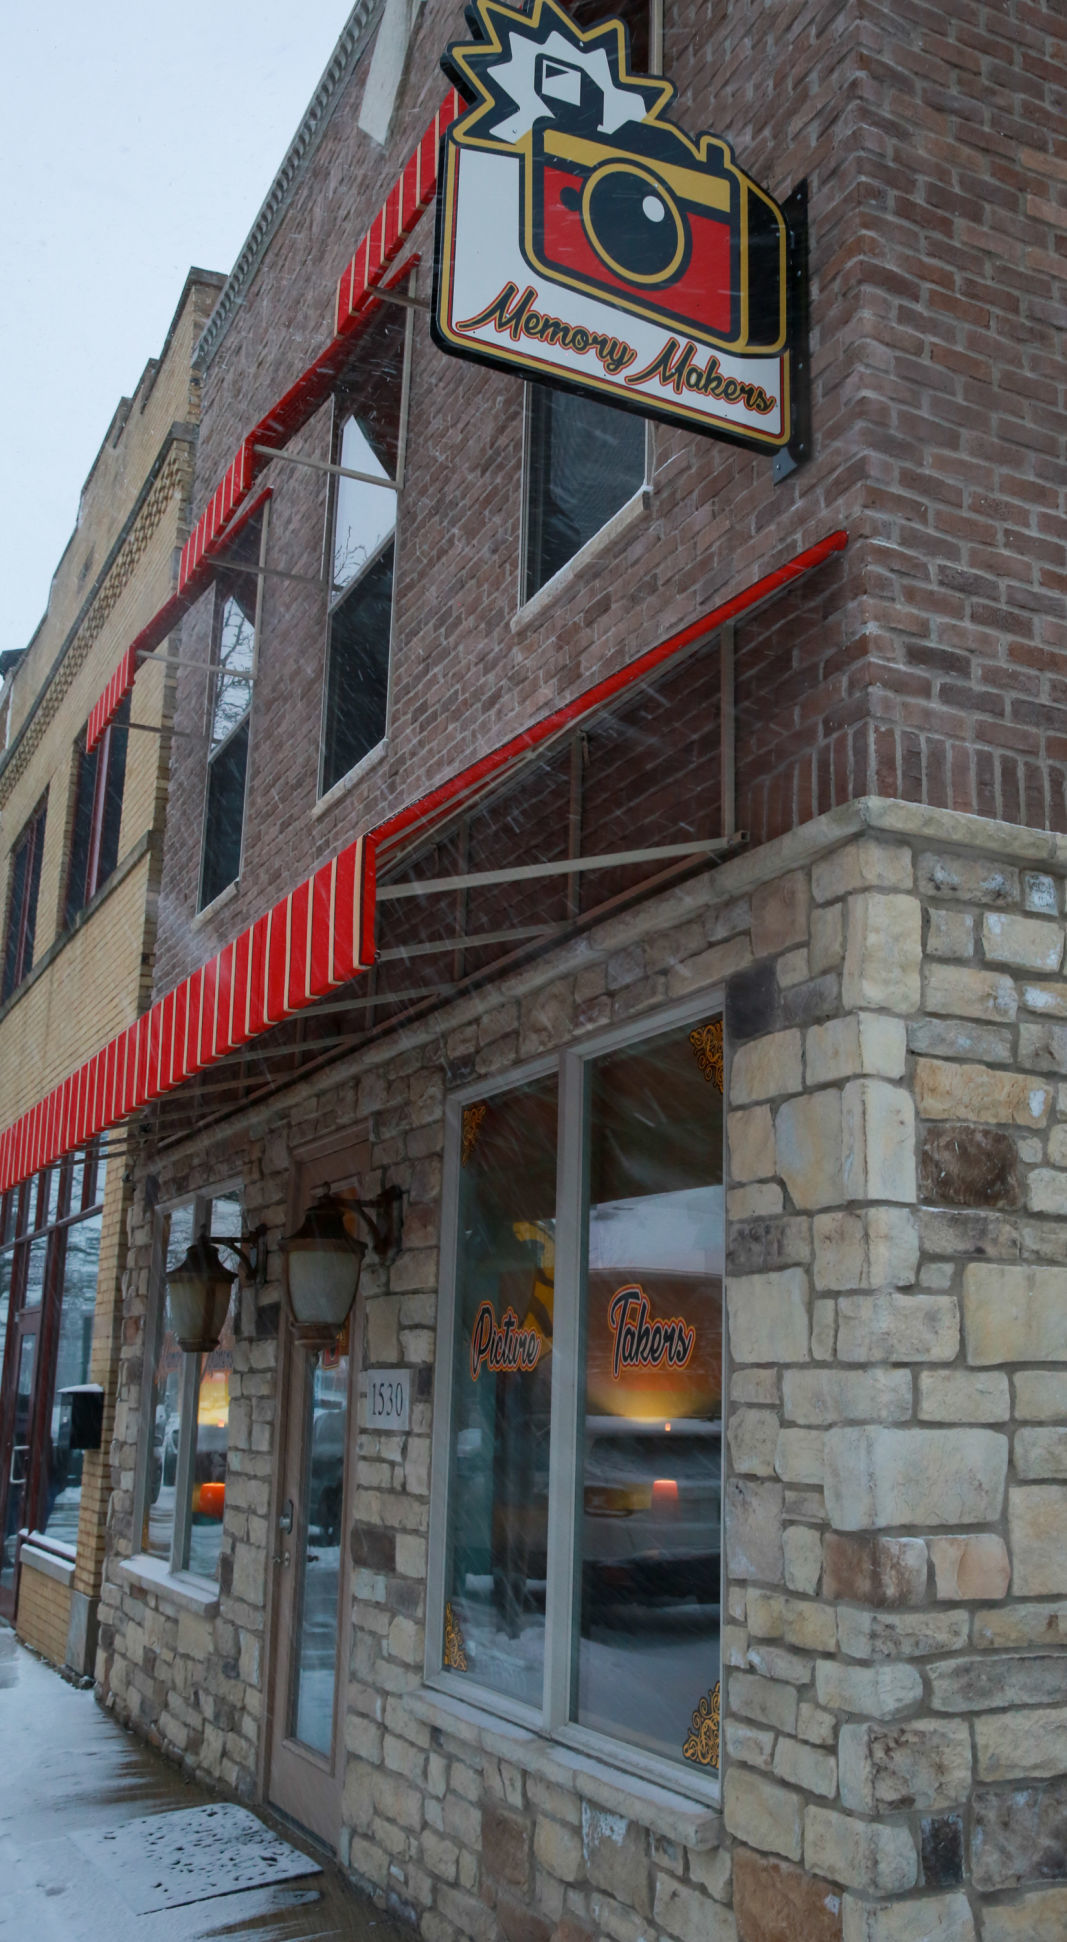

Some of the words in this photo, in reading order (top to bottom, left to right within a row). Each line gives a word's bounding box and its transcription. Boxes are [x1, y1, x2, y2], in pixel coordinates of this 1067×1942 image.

[456, 281, 637, 375] Memory
[625, 337, 777, 414] Makers
[470, 1300, 540, 1381] Picture
[608, 1284, 696, 1381] Takers
[372, 1382, 403, 1417] 1530
